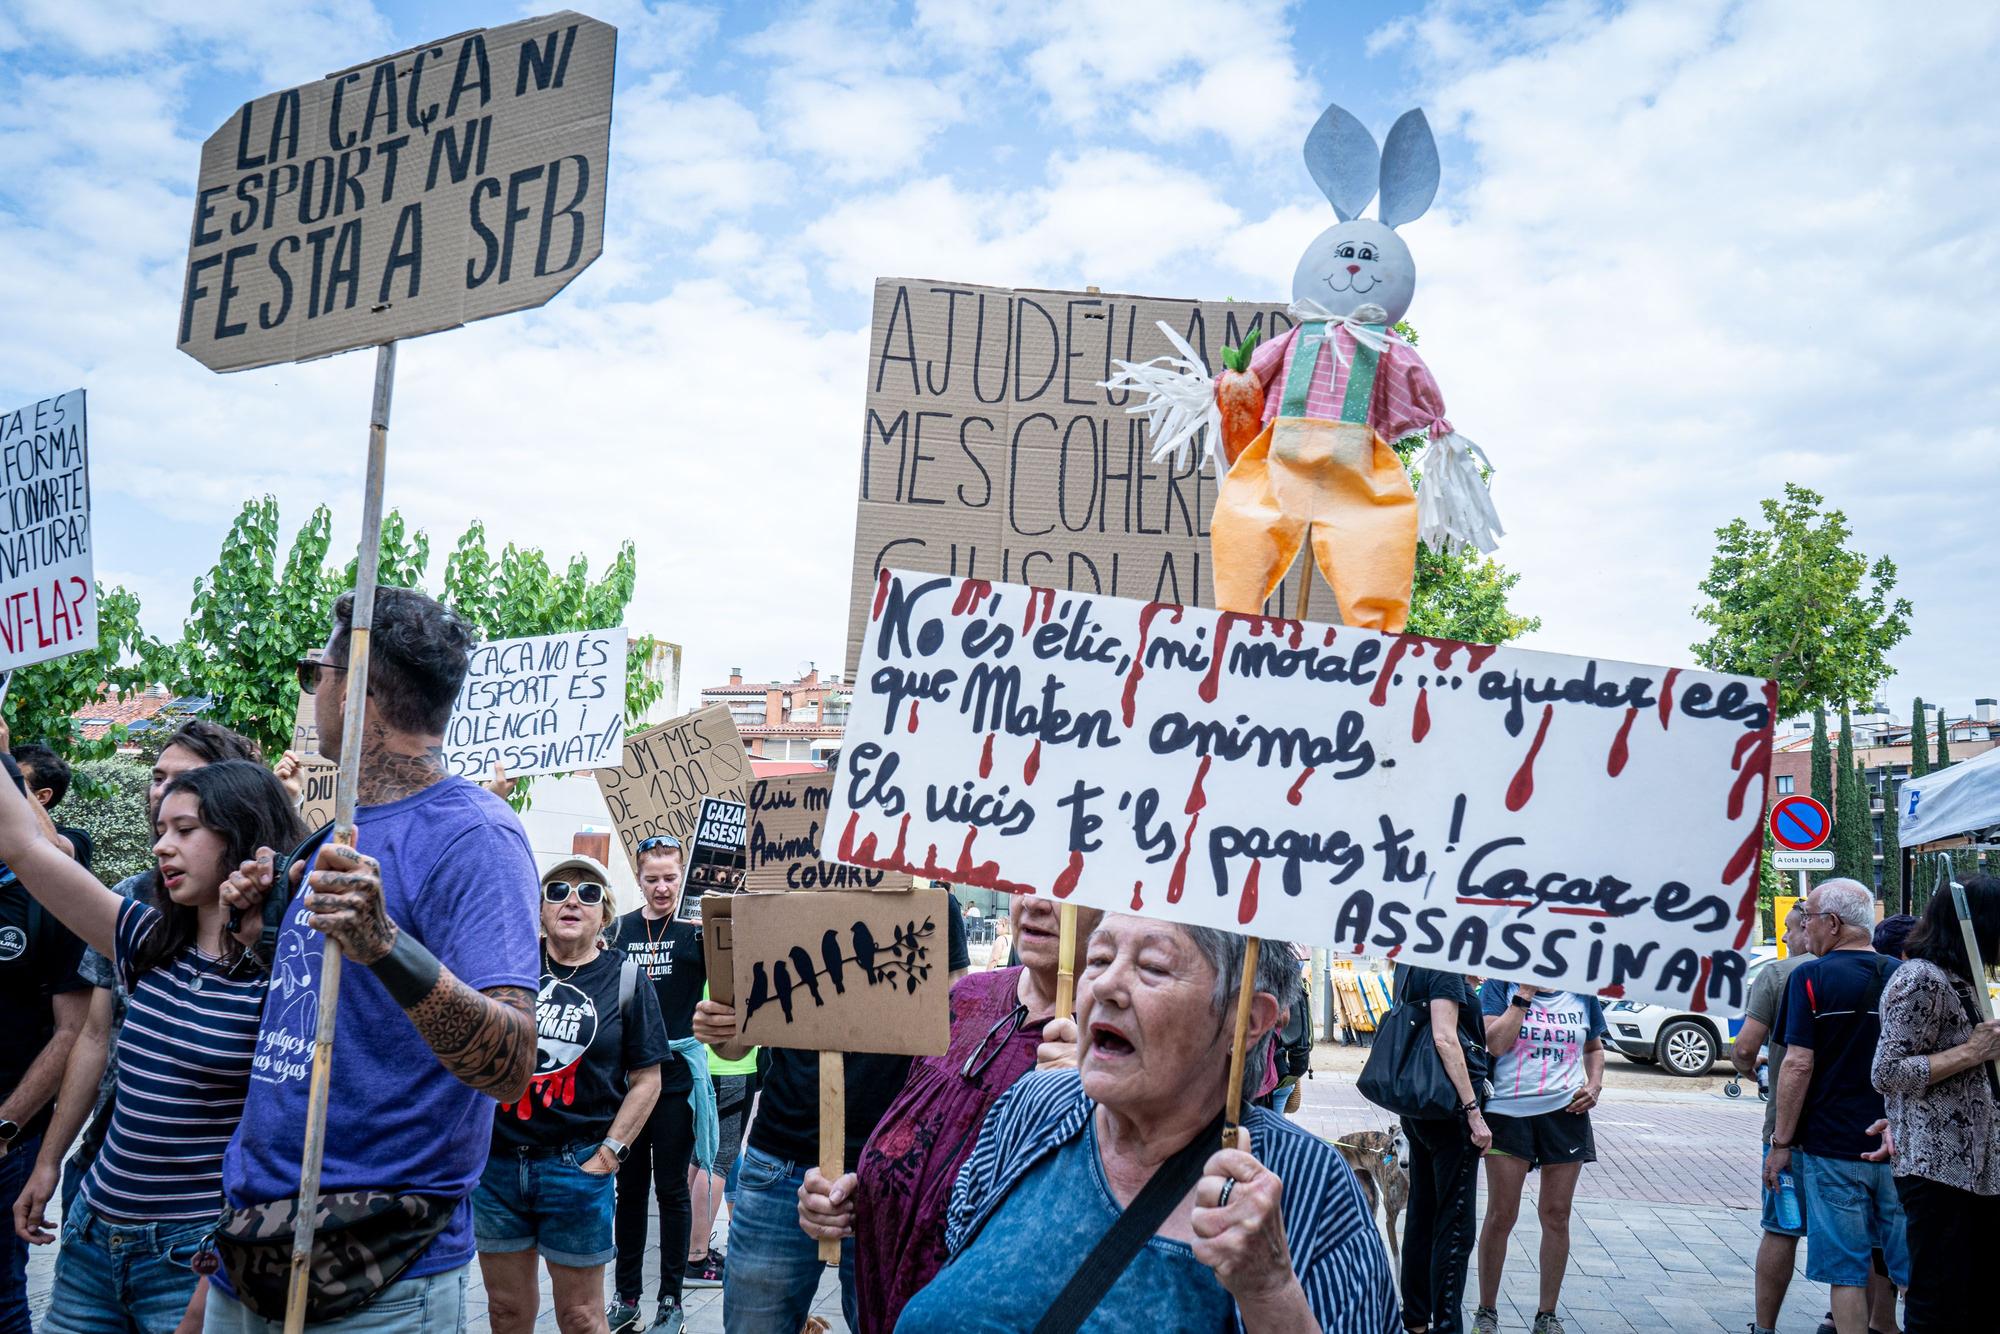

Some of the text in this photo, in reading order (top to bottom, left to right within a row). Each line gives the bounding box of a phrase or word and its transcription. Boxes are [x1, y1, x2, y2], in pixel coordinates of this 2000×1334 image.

[236, 25, 579, 170] LA CAÇA NI
[194, 114, 493, 248] ESPORT NI
[180, 154, 590, 344] FESTA A SFB
[876, 285, 1137, 406] AJUDEU
[0, 394, 65, 443] TA ES
[4, 424, 82, 487] FORMA
[863, 408, 1211, 537] MES COHERE
[0, 466, 83, 536] CIONAR-TE
[0, 576, 87, 654] NT-LA?
[468, 633, 610, 679] CAÇA NO ÉS
[875, 577, 952, 661] No
[1145, 626, 1209, 673] ni
[1479, 659, 1657, 737] ajudar
[568, 670, 607, 700] ÉS
[871, 666, 958, 735] que
[960, 662, 1121, 749] Maten
[294, 725, 320, 754] PE
[605, 787, 639, 825] DE
[750, 779, 797, 827] Qui
[847, 741, 906, 818] Els
[926, 781, 1036, 837] vicis
[1057, 779, 1104, 853] te
[620, 801, 702, 857] PERSONE
[1808, 857, 1830, 865] plaça
[626, 953, 673, 965] ANIMAL
[627, 940, 676, 952] FINS QUE TOT
[536, 1002, 584, 1021] AR ES
[536, 1017, 581, 1043] INAR
[1520, 1026, 1576, 1043] BEACH
[1525, 1008, 1584, 1025] PERDRY
[1531, 1047, 1564, 1063] JPN
